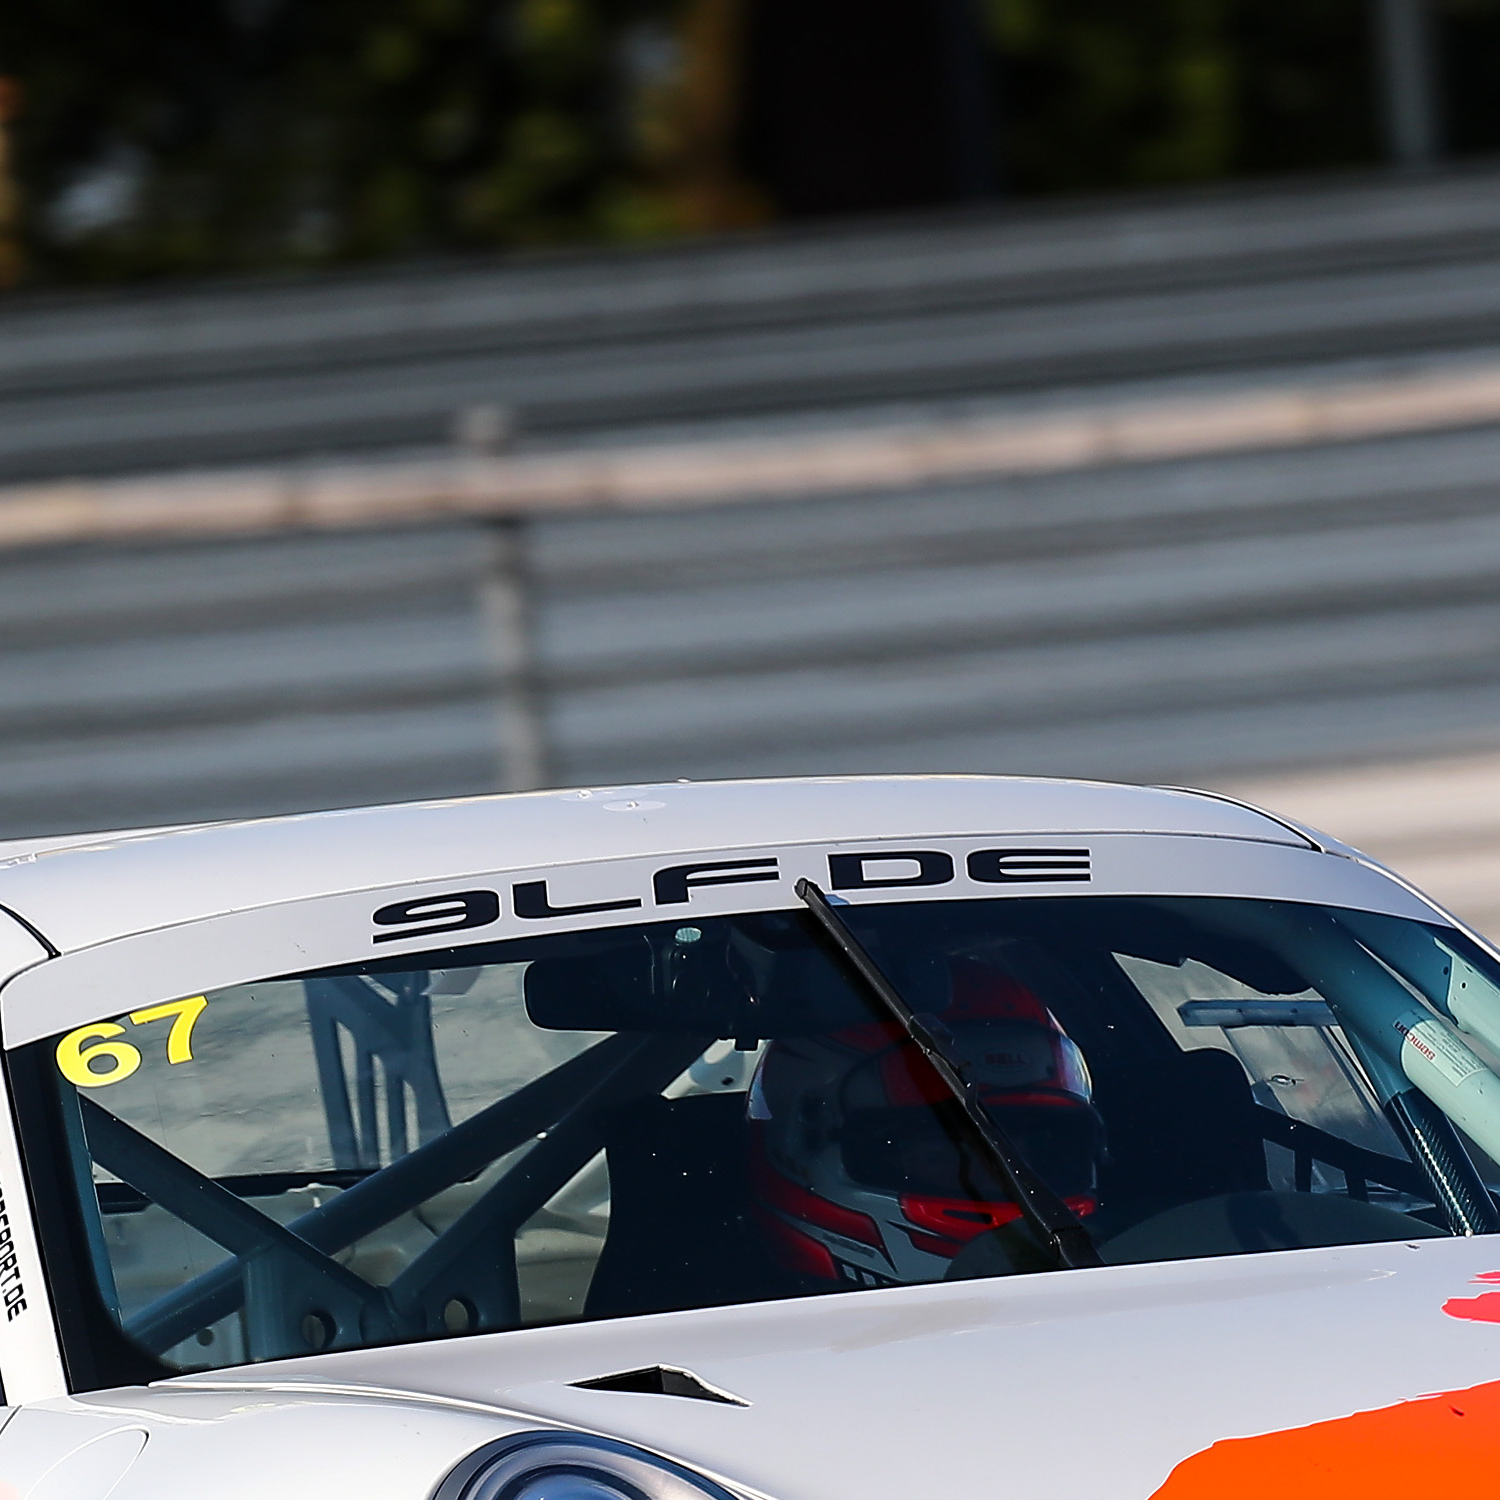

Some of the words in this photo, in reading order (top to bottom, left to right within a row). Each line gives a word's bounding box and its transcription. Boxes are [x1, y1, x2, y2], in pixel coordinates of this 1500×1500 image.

[372, 857, 780, 944] 9LF
[827, 848, 1091, 891] DE
[56, 995, 208, 1088] 67
